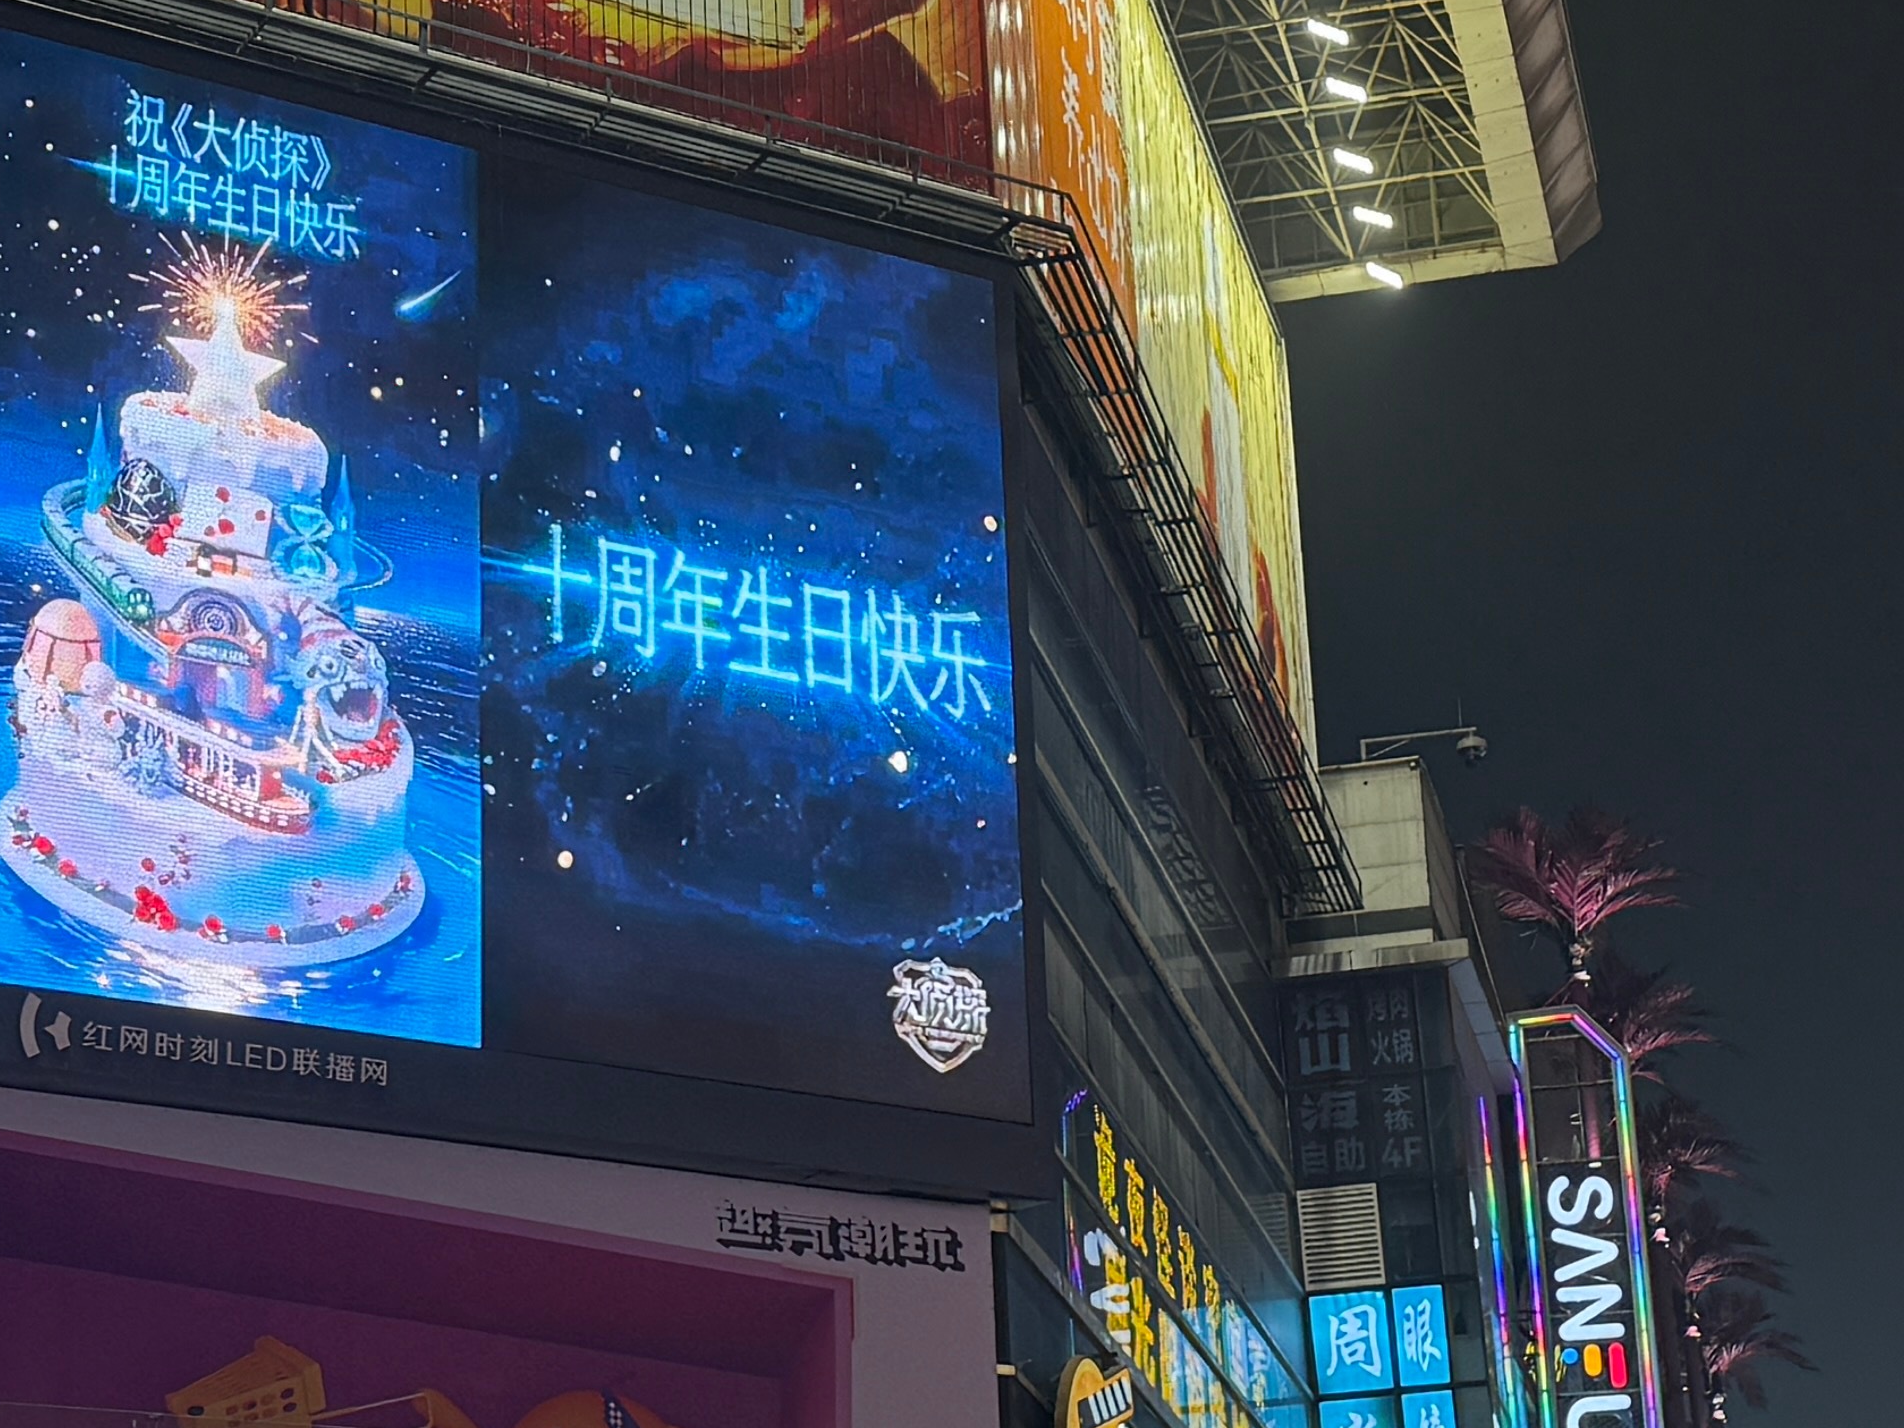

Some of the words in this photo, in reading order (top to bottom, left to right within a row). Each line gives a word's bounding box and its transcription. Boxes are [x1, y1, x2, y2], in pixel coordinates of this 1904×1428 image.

[122, 88, 332, 191] 祝《大侦探》
[92, 144, 362, 258] 十周年生日快乐
[523, 523, 994, 719] 十周年生日快乐
[81, 1020, 390, 1088] 红网时刻LED联播网
